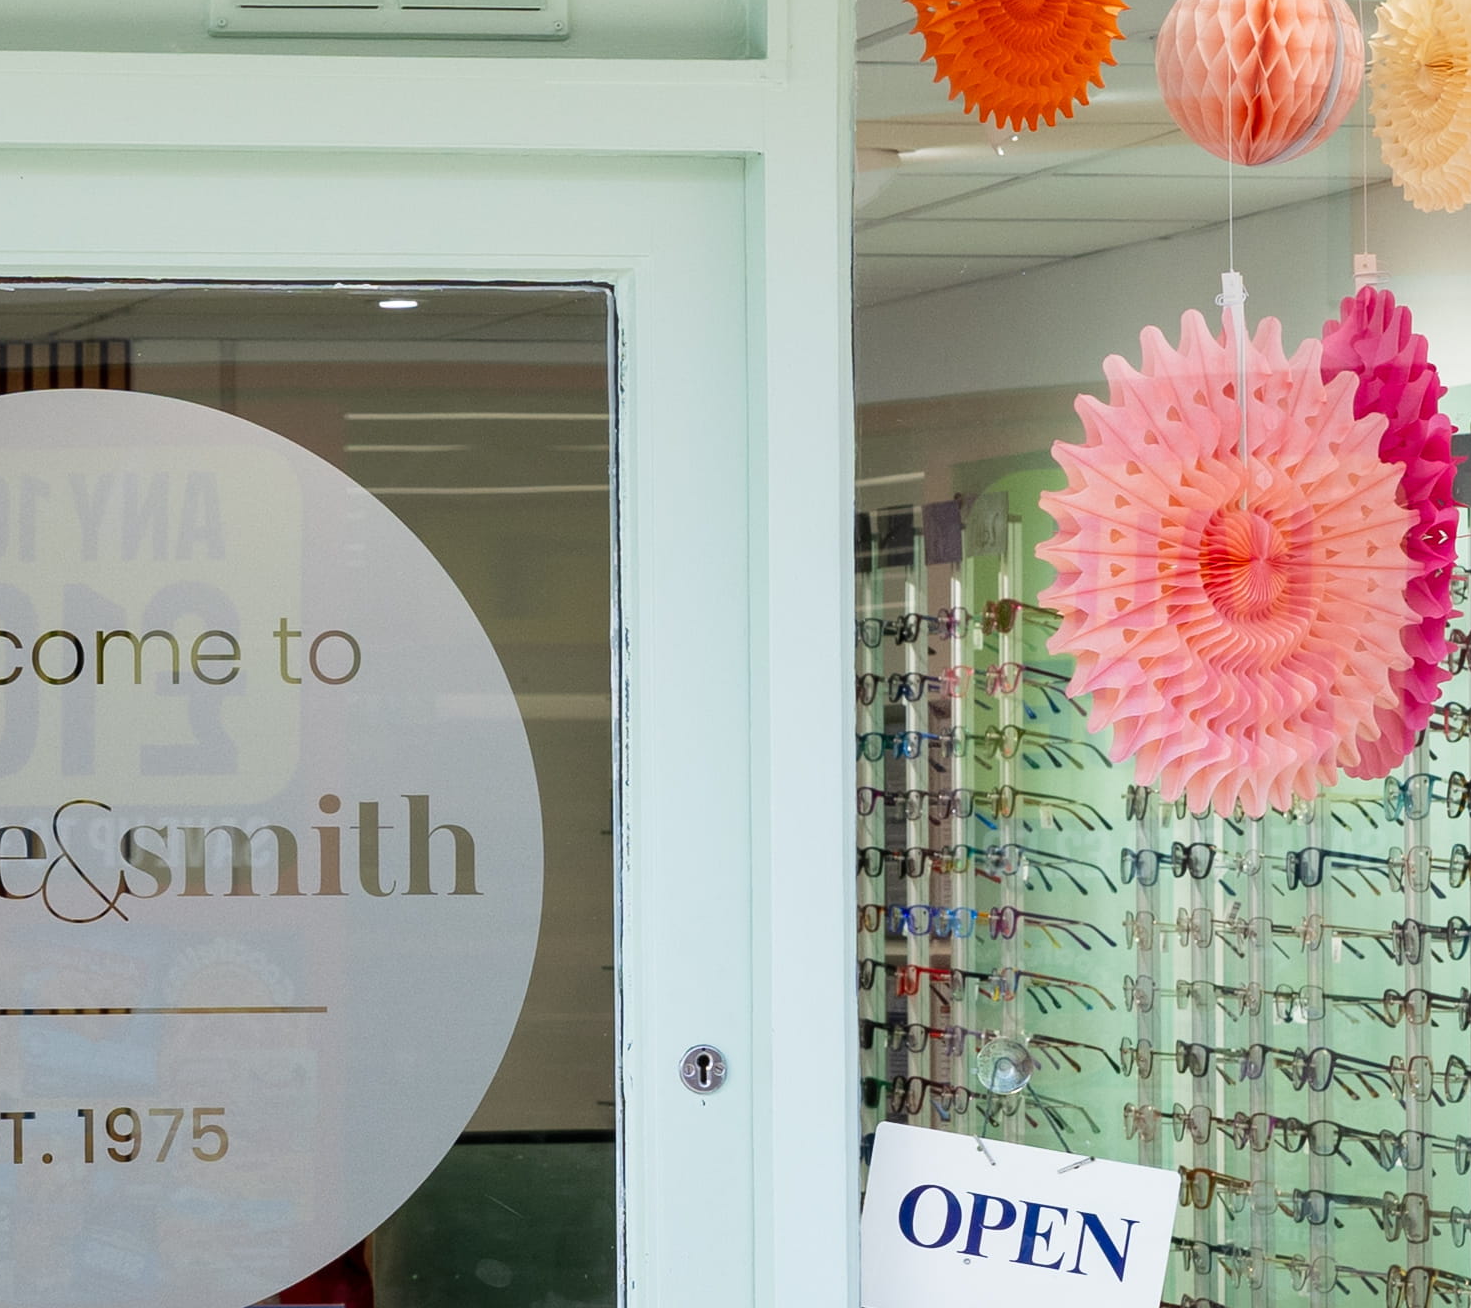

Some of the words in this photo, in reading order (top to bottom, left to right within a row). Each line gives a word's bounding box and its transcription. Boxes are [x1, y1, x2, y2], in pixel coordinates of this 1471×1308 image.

[272, 616, 363, 688] to
[80, 1106, 233, 1166] 1975
[898, 1184, 1140, 1283] OPEN
